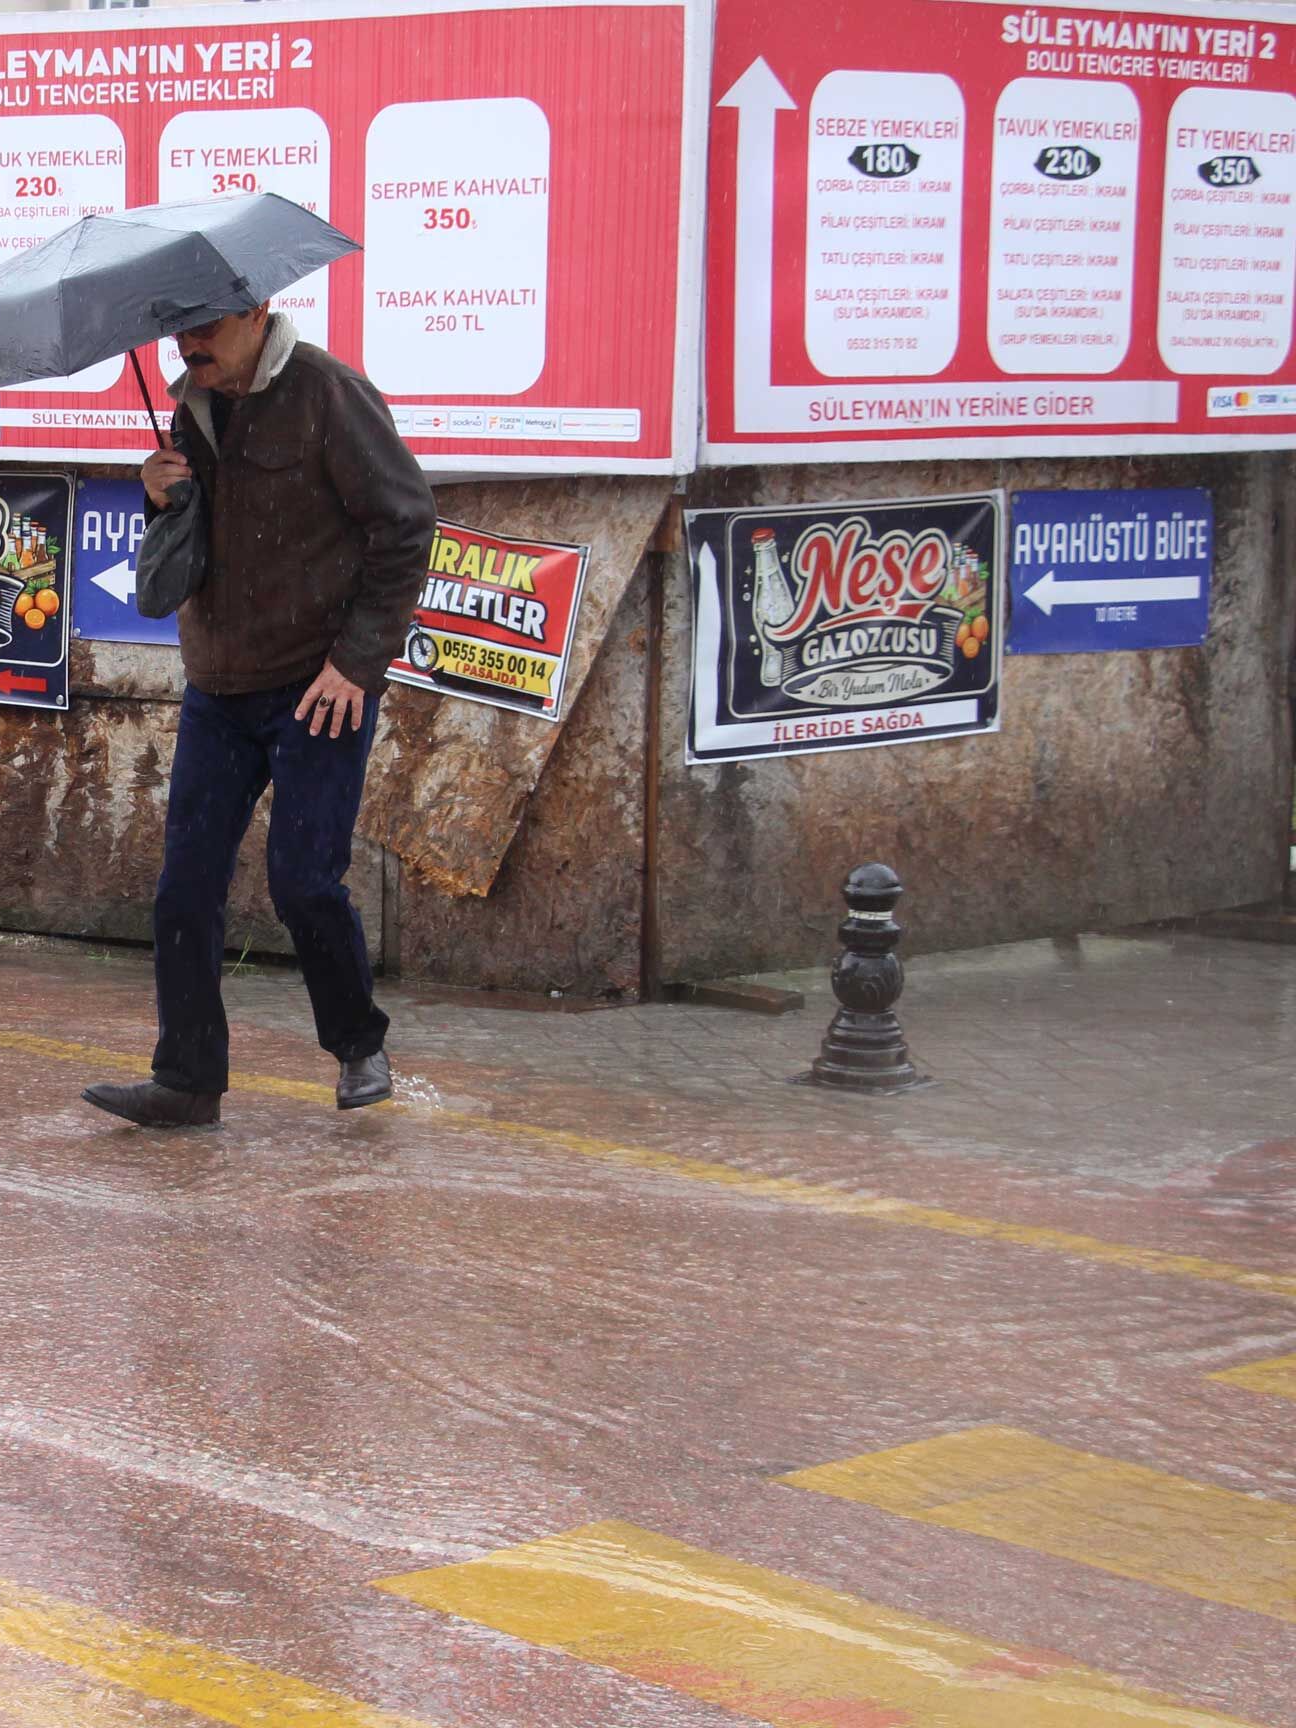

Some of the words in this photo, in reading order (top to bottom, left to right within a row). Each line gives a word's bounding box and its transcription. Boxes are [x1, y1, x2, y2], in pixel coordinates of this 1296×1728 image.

[1001, 10, 1189, 53] SÜLEYMAN'IN
[1195, 25, 1255, 58] YERİ
[1259, 33, 1276, 59] 2
[195, 33, 280, 72] YERİ
[290, 38, 313, 69] 2
[1026, 51, 1073, 72] BOLU
[1076, 53, 1154, 76] TENCERE
[1157, 58, 1249, 83] YEMEKLERİ
[36, 82, 139, 106] TENCERE
[145, 71, 274, 102] YEMEKLERİ
[816, 118, 866, 136] SEBZE
[872, 117, 959, 138] YEMEKLERİ
[999, 118, 1047, 137] TAVUK
[1054, 119, 1136, 141] YEMEKLERİ
[1177, 128, 1197, 147] ET
[1203, 129, 1295, 153] YEMEKLERİ
[27, 145, 122, 167] YEMEKLERİ
[170, 149, 195, 168] ET
[201, 140, 318, 167] YEMEKLERİ
[371, 180, 448, 200] SERPME
[454, 178, 547, 196] KAHVALTI
[376, 290, 437, 308] TABAK
[444, 288, 536, 306] KAHVALTI
[424, 315, 457, 332] 250
[463, 315, 484, 331] TL
[32, 410, 137, 425] SÜLEYMAN'IN
[142, 414, 172, 427] YER
[809, 397, 950, 421] SÜLEYMAN'IN
[956, 392, 1028, 416] YERİNE
[1034, 391, 1094, 415] GİDER
[1014, 513, 1148, 565] AYAKÜSTÜ
[1155, 512, 1207, 560] BÜFE
[428, 529, 542, 593] İRALIK
[765, 517, 950, 641] Neşe
[418, 578, 546, 640] İKLETLER
[443, 639, 476, 662] 0555
[478, 646, 504, 670] 355
[508, 655, 527, 675] 00
[530, 660, 546, 679] 14
[803, 627, 937, 666] GAZOZCUSU
[462, 665, 518, 687] PASAJDA
[818, 680, 839, 698] Bir
[842, 677, 885, 700] Yudum
[888, 670, 923, 692] Mola
[773, 718, 854, 741] İLERİDE
[862, 711, 924, 732] SAĞDA
